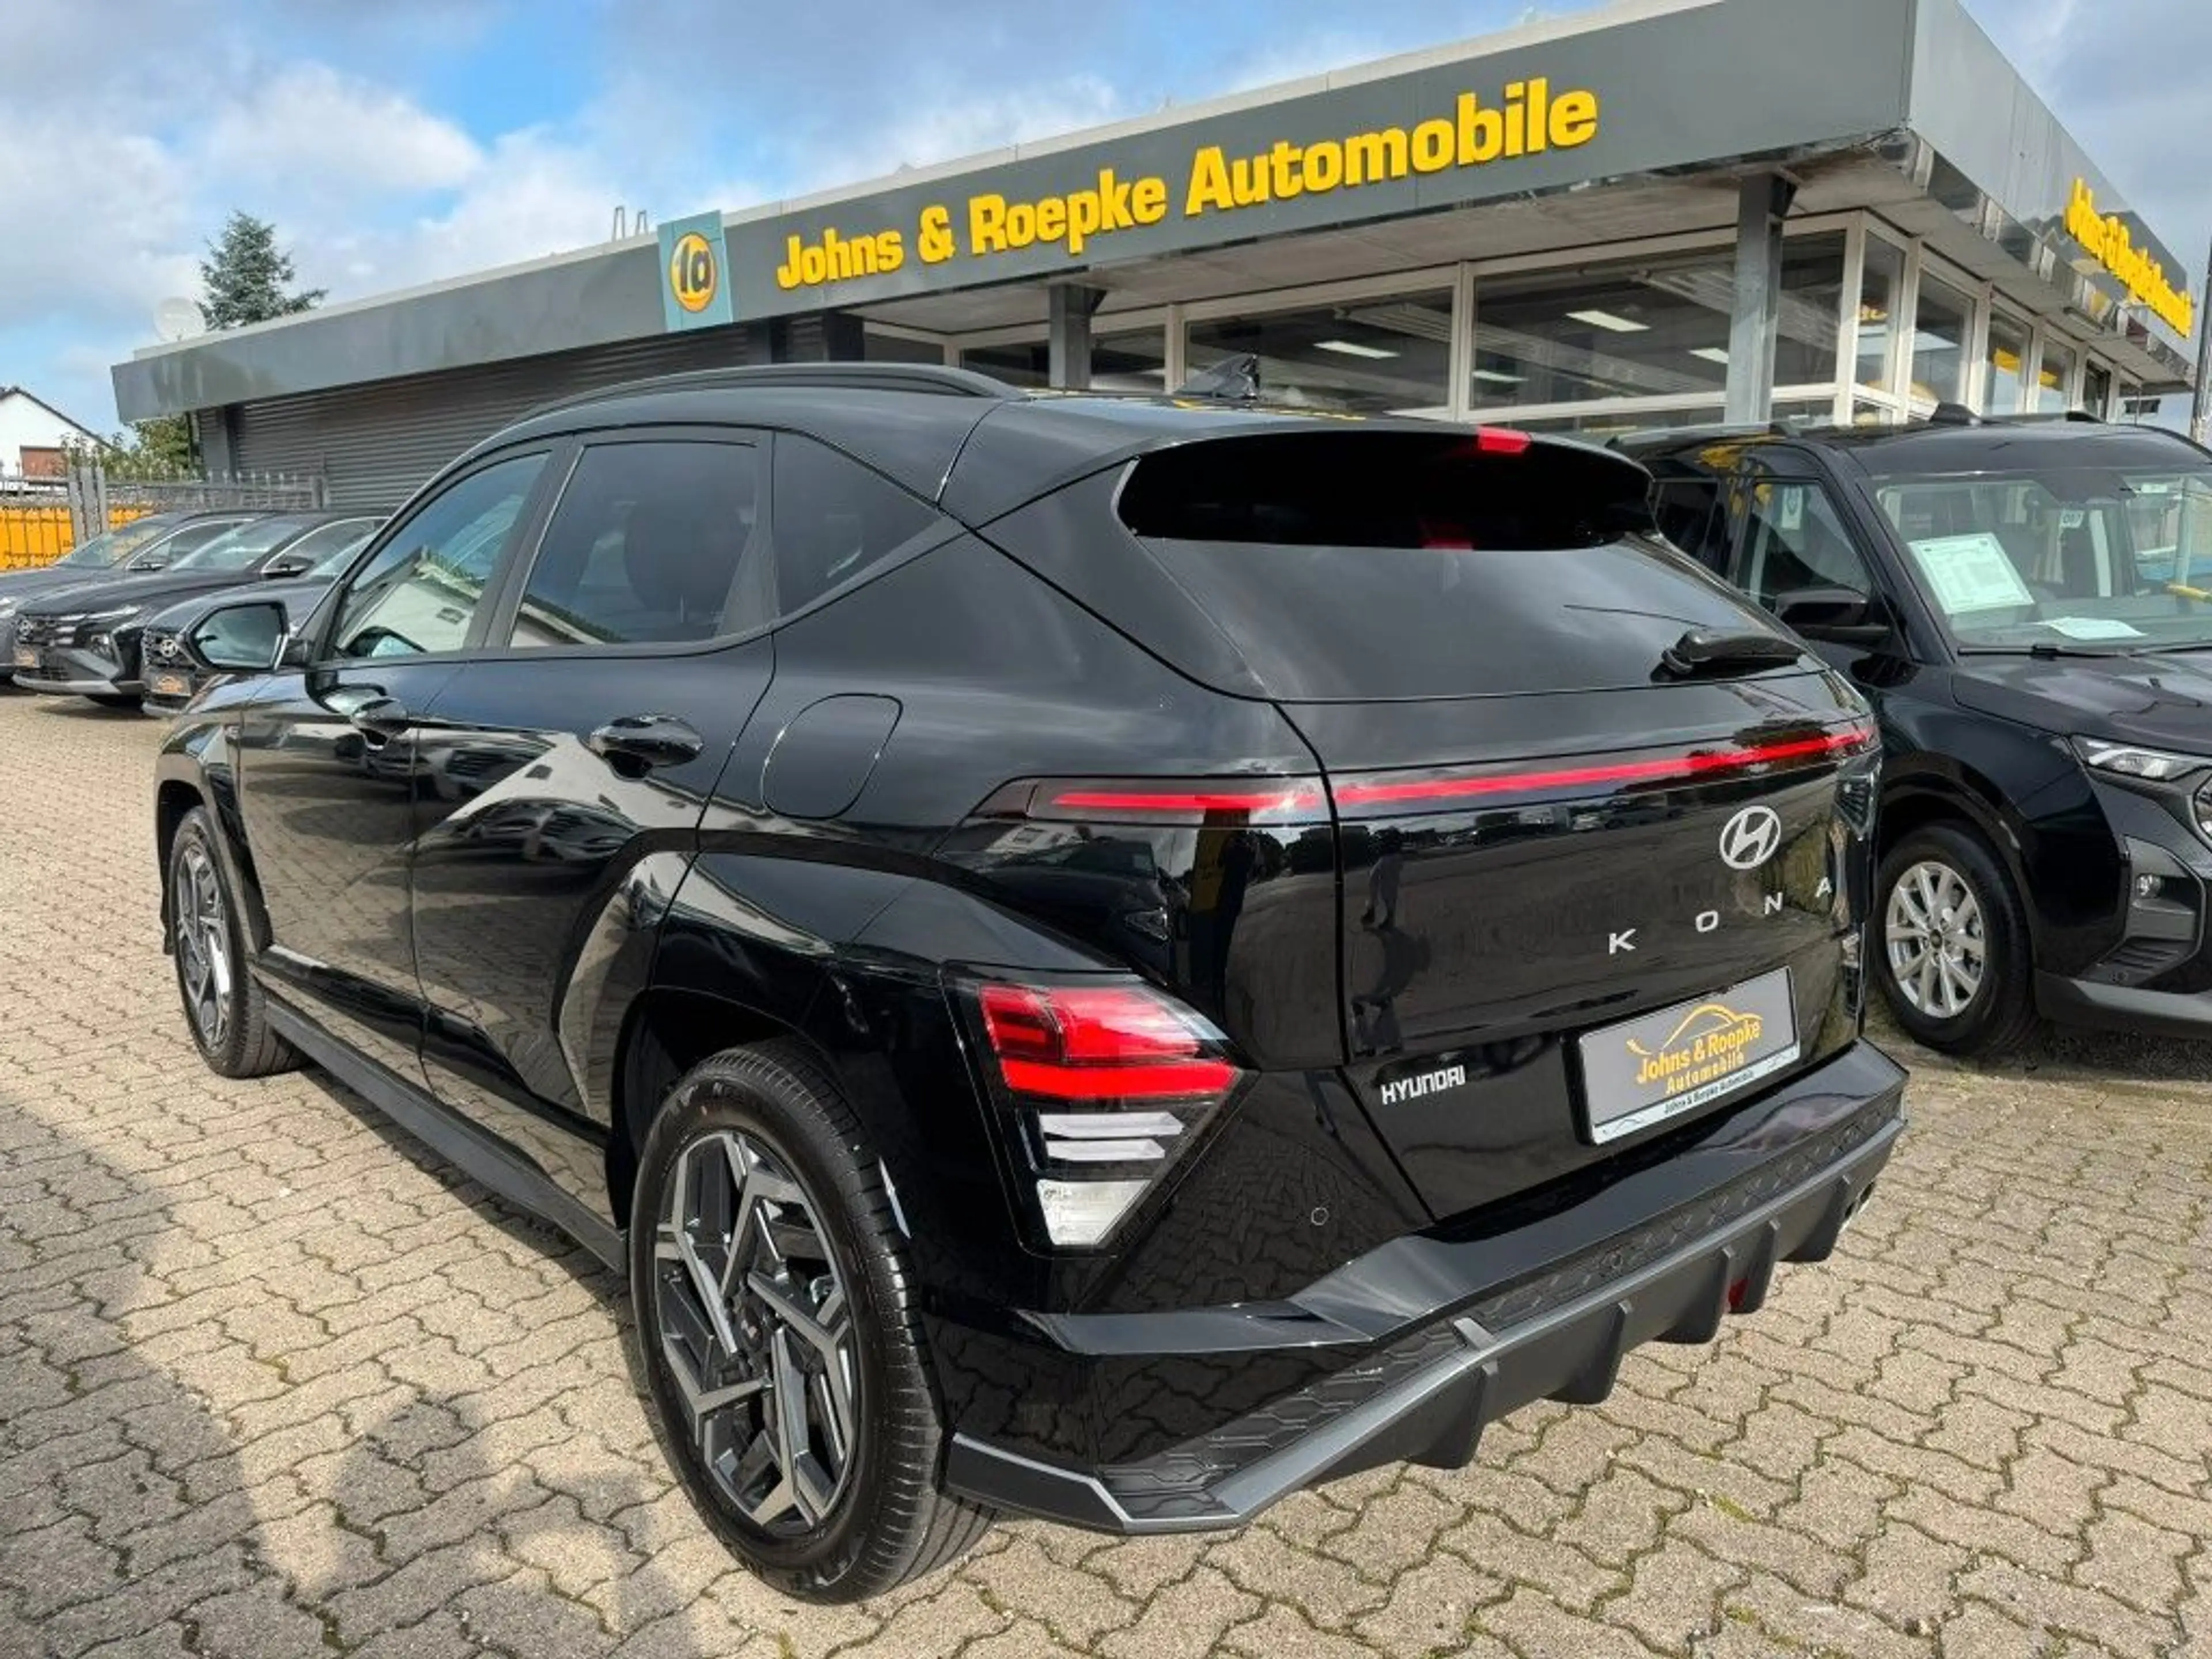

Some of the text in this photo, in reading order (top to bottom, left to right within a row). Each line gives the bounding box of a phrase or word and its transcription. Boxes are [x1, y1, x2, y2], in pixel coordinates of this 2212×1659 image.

[777, 77, 1599, 290] Johns & Roepke Automobile
[1637, 1020, 1761, 1084] Johns & Roepke
[1666, 1051, 1745, 1095] Automobile
[1381, 1065, 1465, 1105] HYUNDAI
